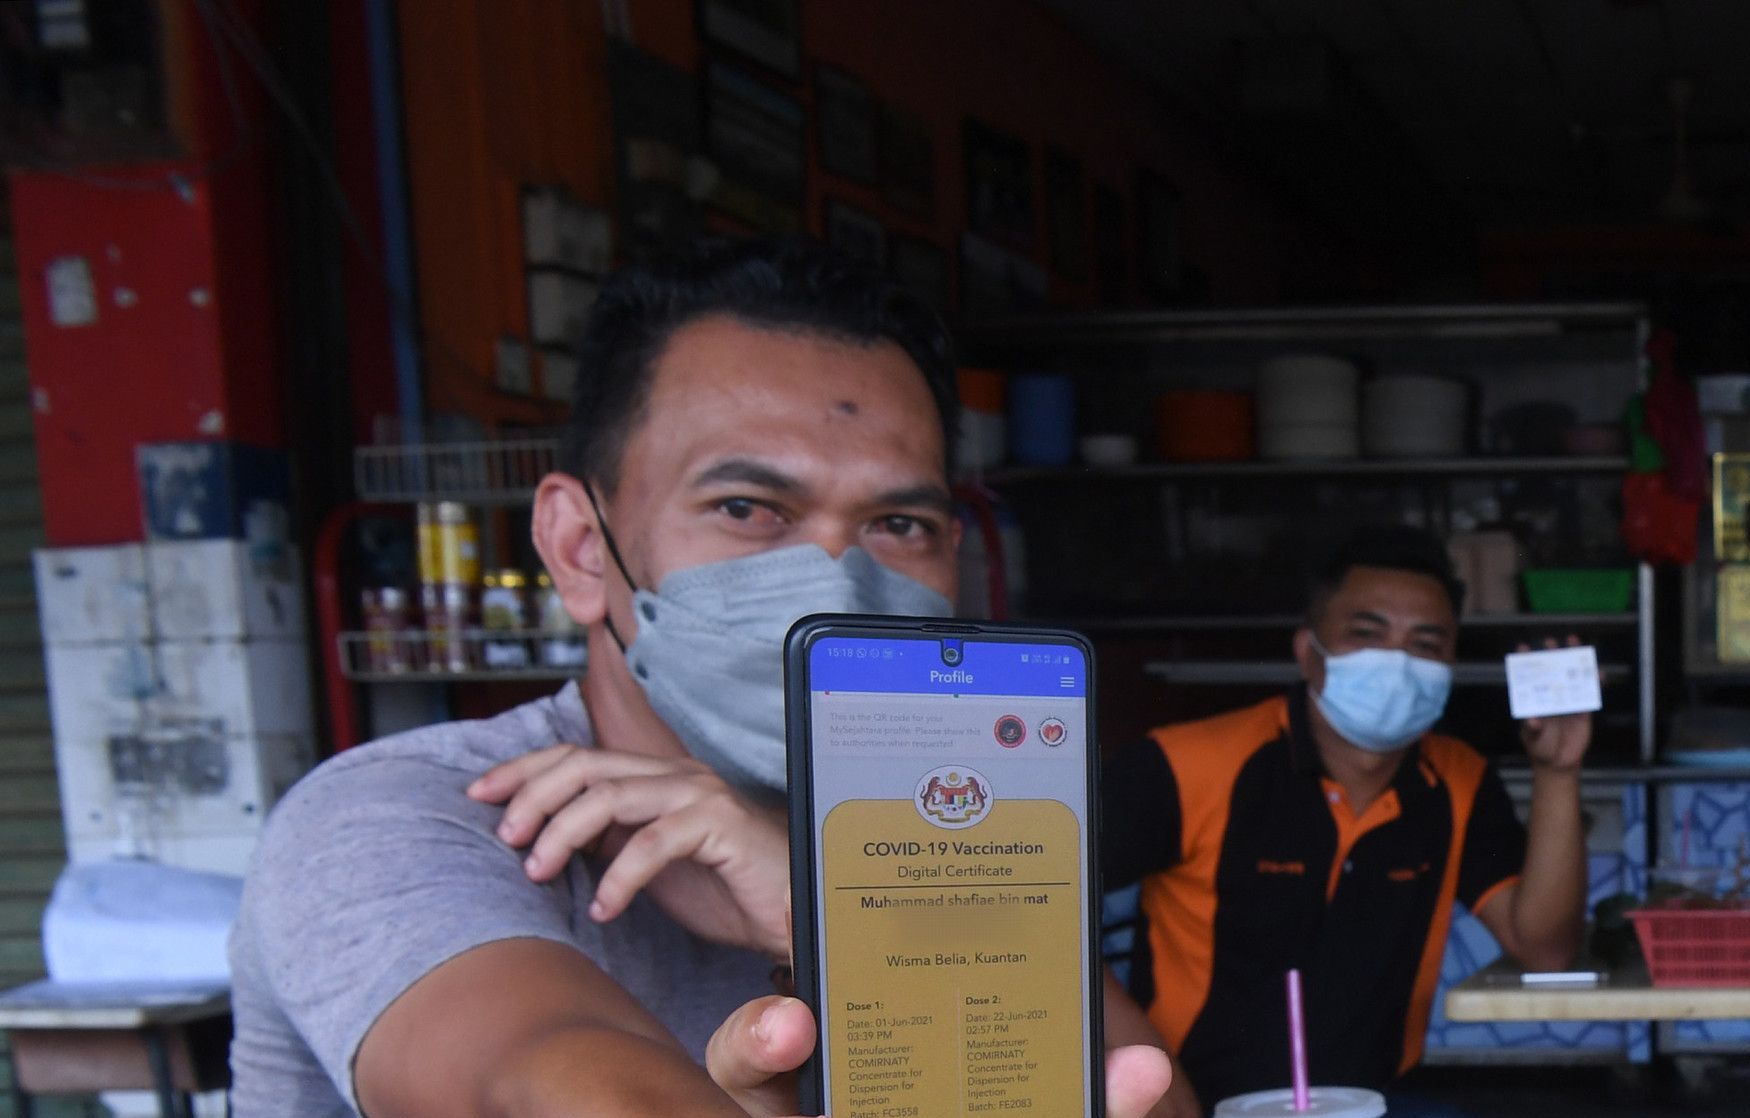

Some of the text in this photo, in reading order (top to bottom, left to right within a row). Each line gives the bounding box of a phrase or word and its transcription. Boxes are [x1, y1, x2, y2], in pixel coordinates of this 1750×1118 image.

[930, 670, 974, 684] Profile
[863, 841, 1044, 858] COVID-19 Vaccination
[897, 864, 1013, 881] Digital Certificate
[861, 893, 1049, 909] Muhammad shafiae bin mat
[886, 952, 1027, 967] Wisma Belia, Kuantan
[846, 1001, 884, 1011] Dose 1:
[965, 995, 1001, 1006] Dose 2:
[993, 1010, 1048, 1021] 22-Jun-2021
[847, 1016, 933, 1029] Date: 01-Jun-2021
[966, 1024, 1009, 1035] 02:57 PM
[847, 1030, 892, 1042] 03:39 PM
[966, 1038, 1028, 1049] Manufacturer:
[848, 1045, 913, 1056] Manufacturer:
[967, 1061, 1037, 1073] Concentrate for
[848, 1068, 922, 1081] Concentrate for
[967, 1073, 1029, 1086] Dispersion for
[849, 1081, 914, 1094] Dispersion for
[967, 1088, 1006, 1099] Injection
[849, 1096, 889, 1108] Injection
[968, 1102, 995, 1112] Batch:
